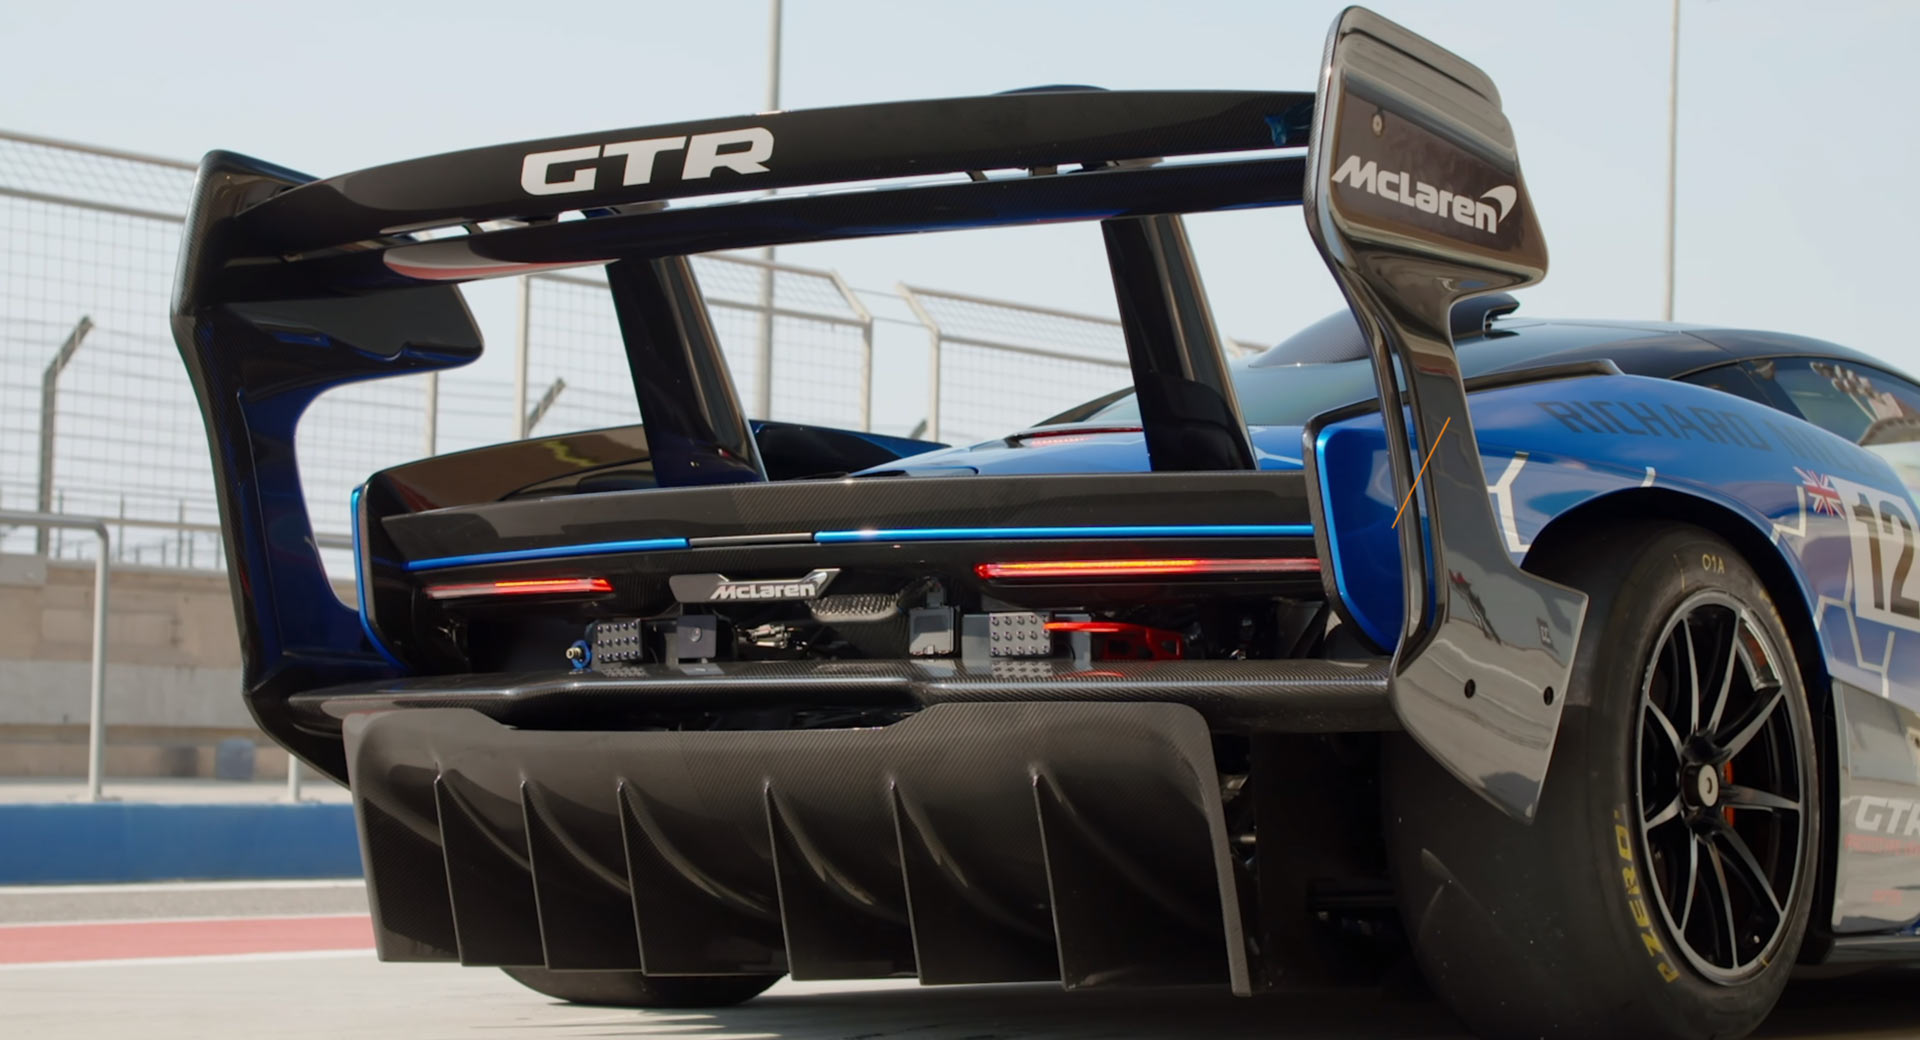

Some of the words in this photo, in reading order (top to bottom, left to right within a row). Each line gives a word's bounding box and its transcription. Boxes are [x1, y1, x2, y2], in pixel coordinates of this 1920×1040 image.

[521, 127, 775, 196] GTR
[1331, 155, 1497, 234] McLaren
[1536, 401, 1772, 451] RICHARD
[1853, 492, 1920, 620] 12
[710, 583, 816, 600] McLaren
